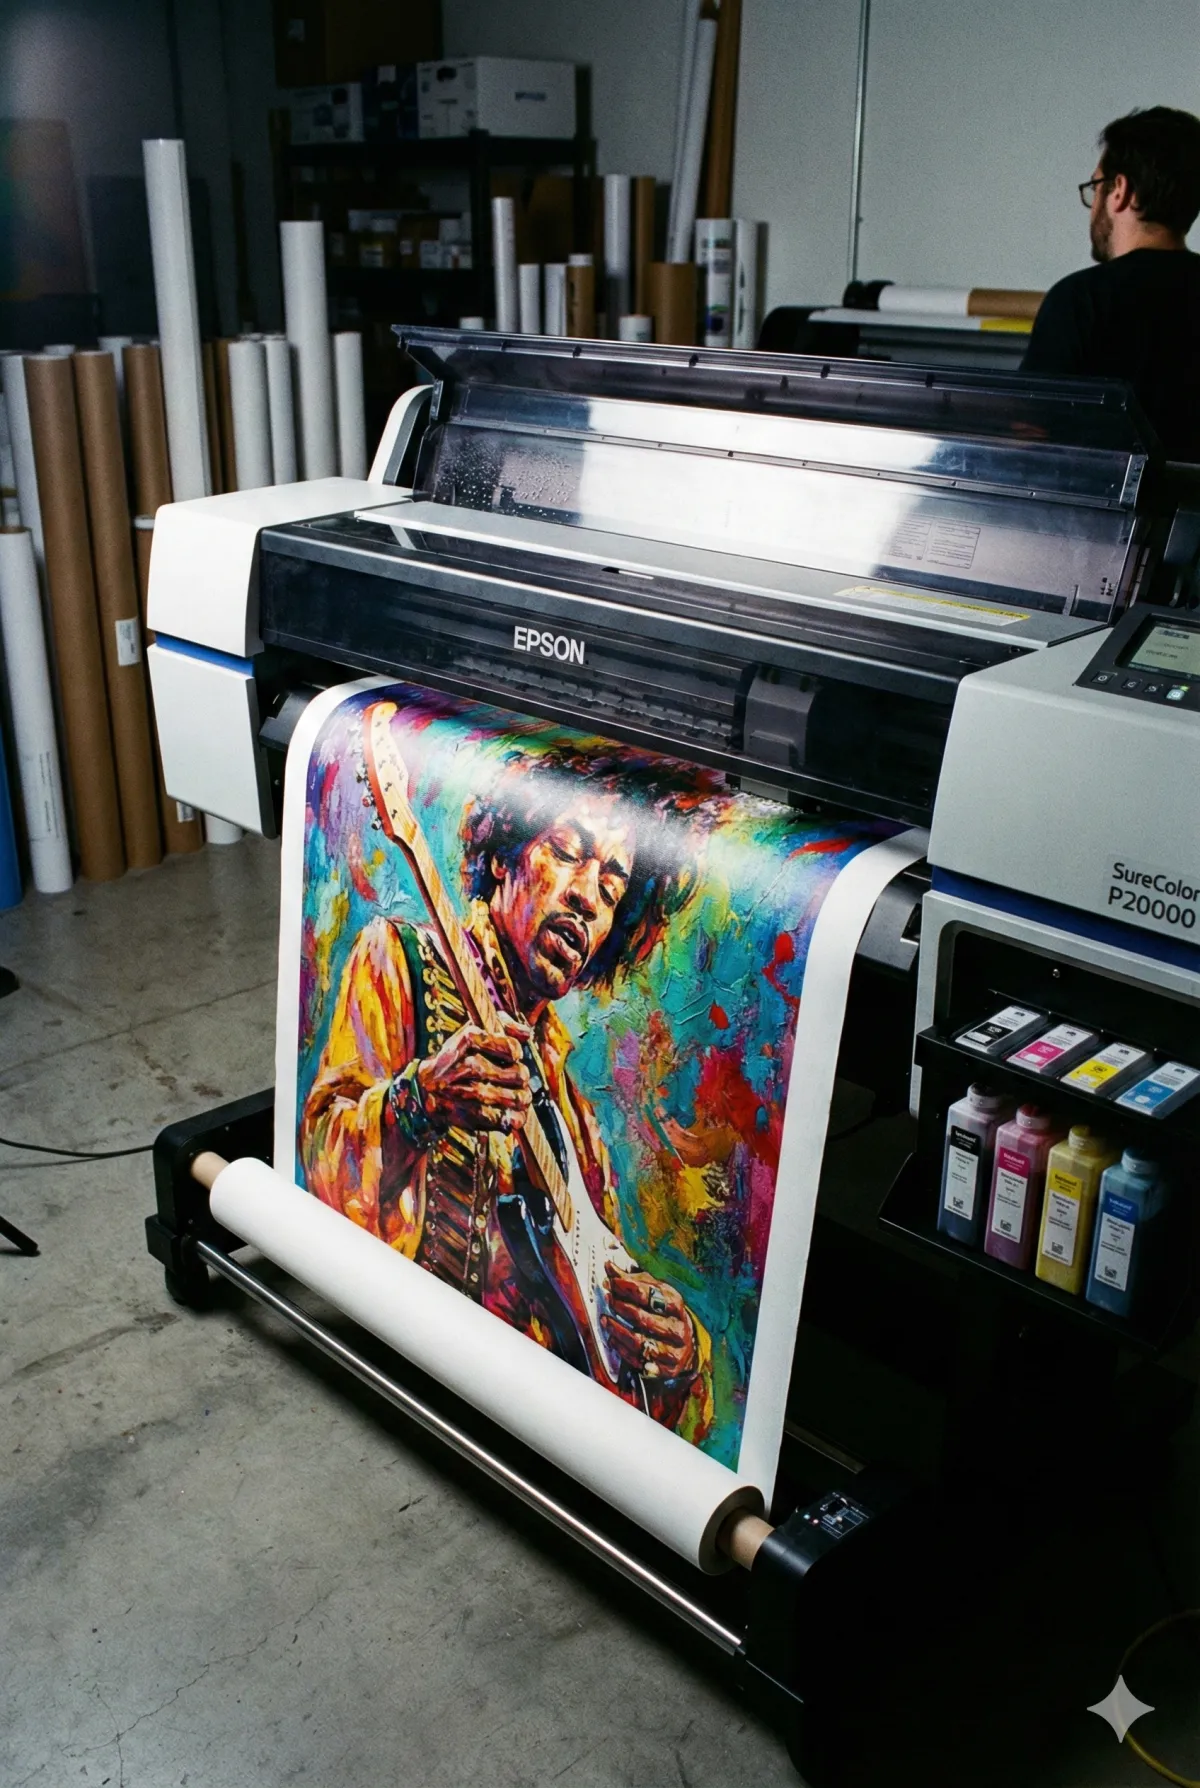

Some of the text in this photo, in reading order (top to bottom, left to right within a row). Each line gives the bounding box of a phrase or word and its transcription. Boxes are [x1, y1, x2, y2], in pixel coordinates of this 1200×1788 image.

[514, 625, 585, 665] EPSON
[1112, 862, 1200, 902] SureColor
[1108, 886, 1196, 929] P20000
